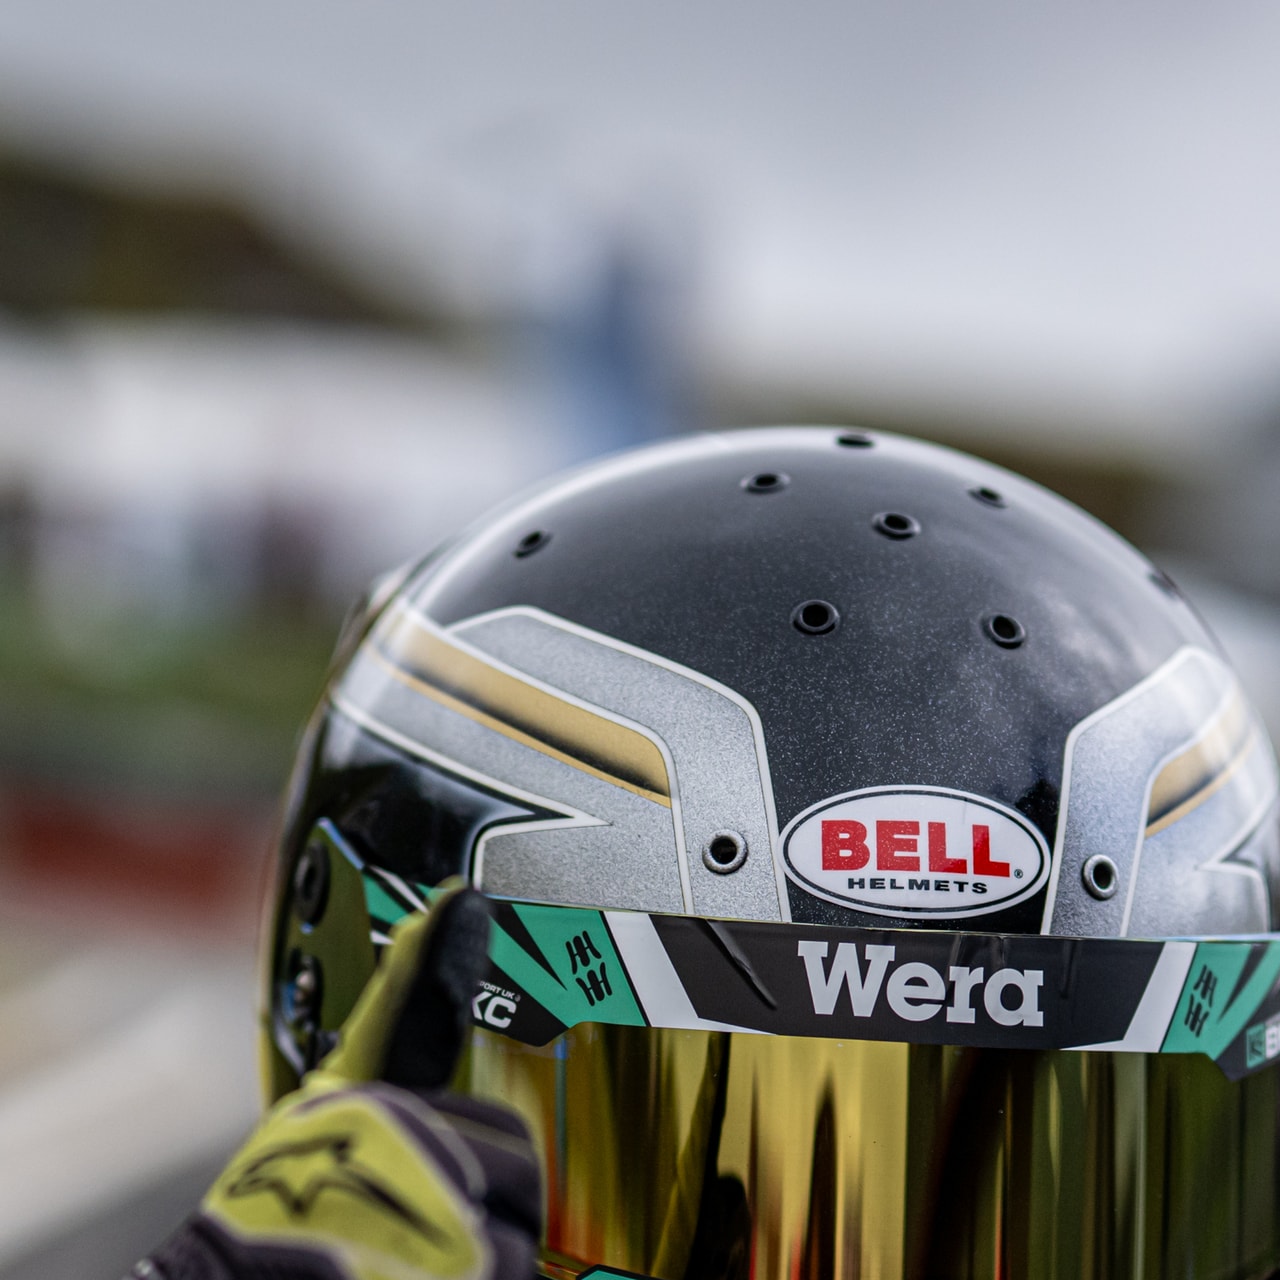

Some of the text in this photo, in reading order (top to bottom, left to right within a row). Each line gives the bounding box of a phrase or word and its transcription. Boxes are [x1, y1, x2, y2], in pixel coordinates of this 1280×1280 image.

[821, 820, 1010, 877] BELL
[848, 878, 988, 894] HELMETS
[797, 940, 1044, 1027] Wera
